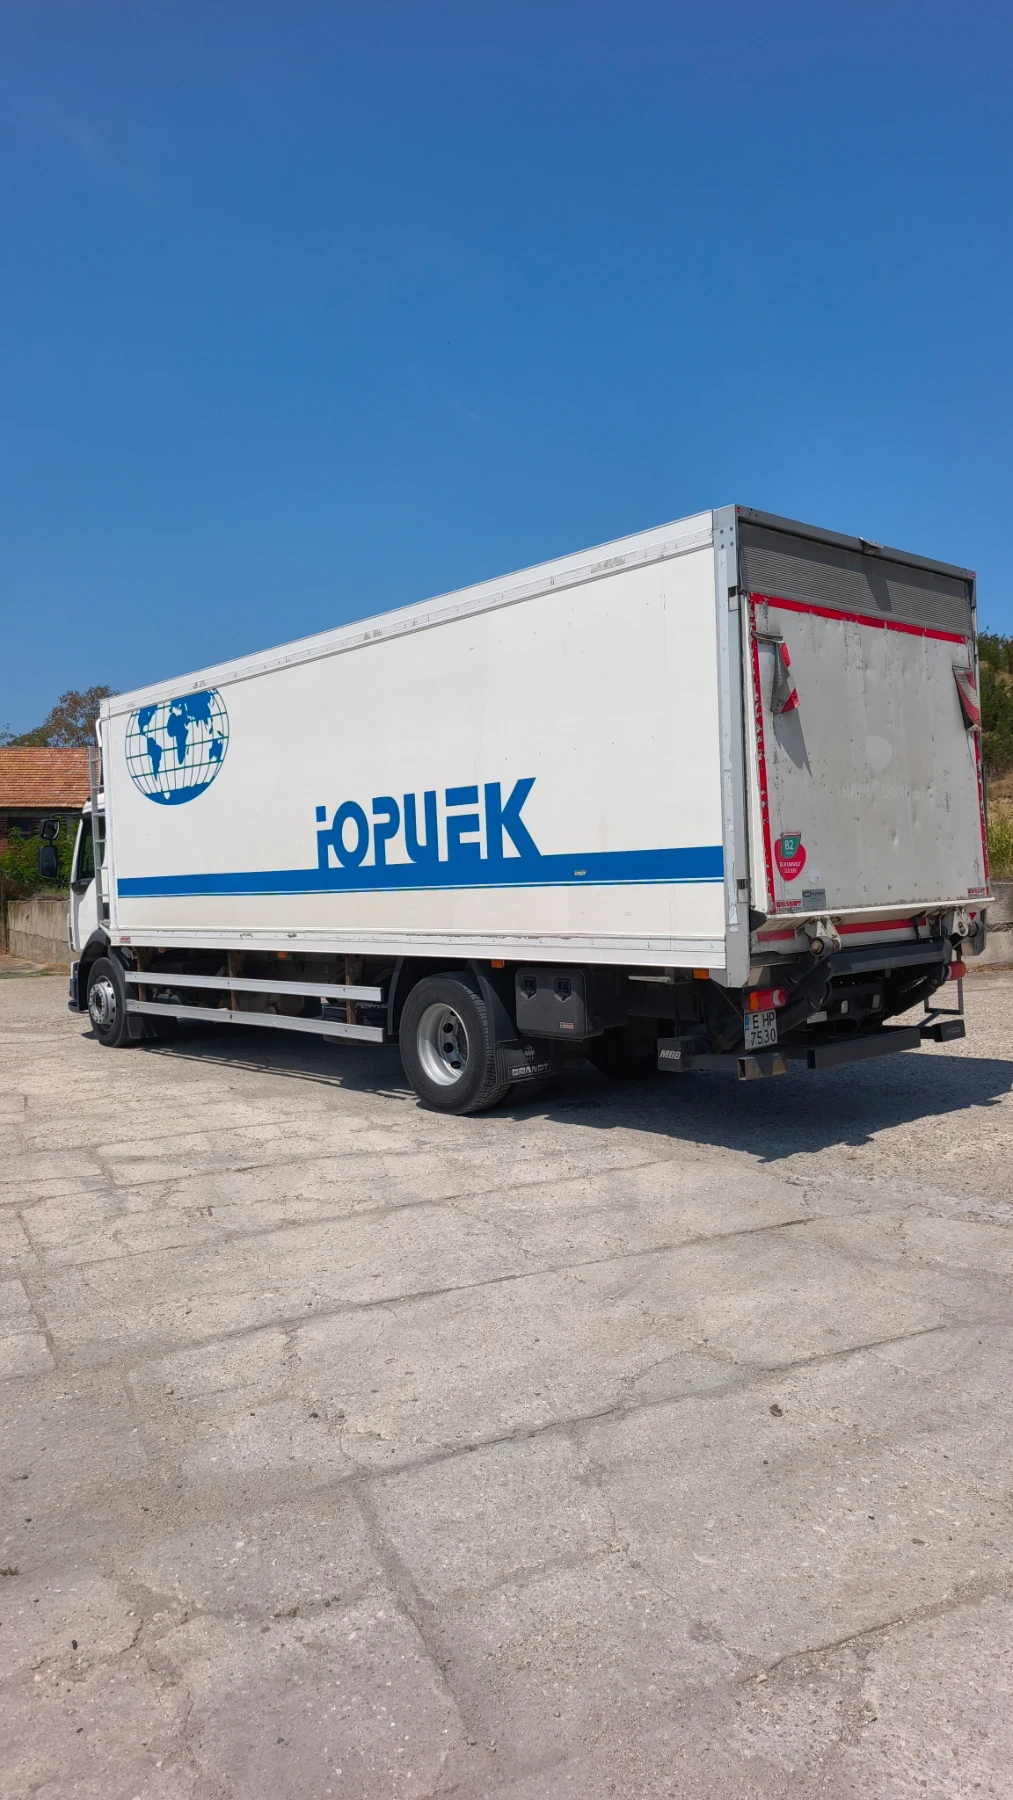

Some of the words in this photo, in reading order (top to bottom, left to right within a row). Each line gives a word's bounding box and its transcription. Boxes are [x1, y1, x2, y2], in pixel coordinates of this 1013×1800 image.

[784, 840, 794, 850] 82
[752, 1014, 759, 1029] E
[762, 1012, 775, 1027] HP
[750, 1028, 776, 1046] 7530
[659, 1049, 681, 1060] MBB
[511, 1063, 549, 1077] BRANDT
